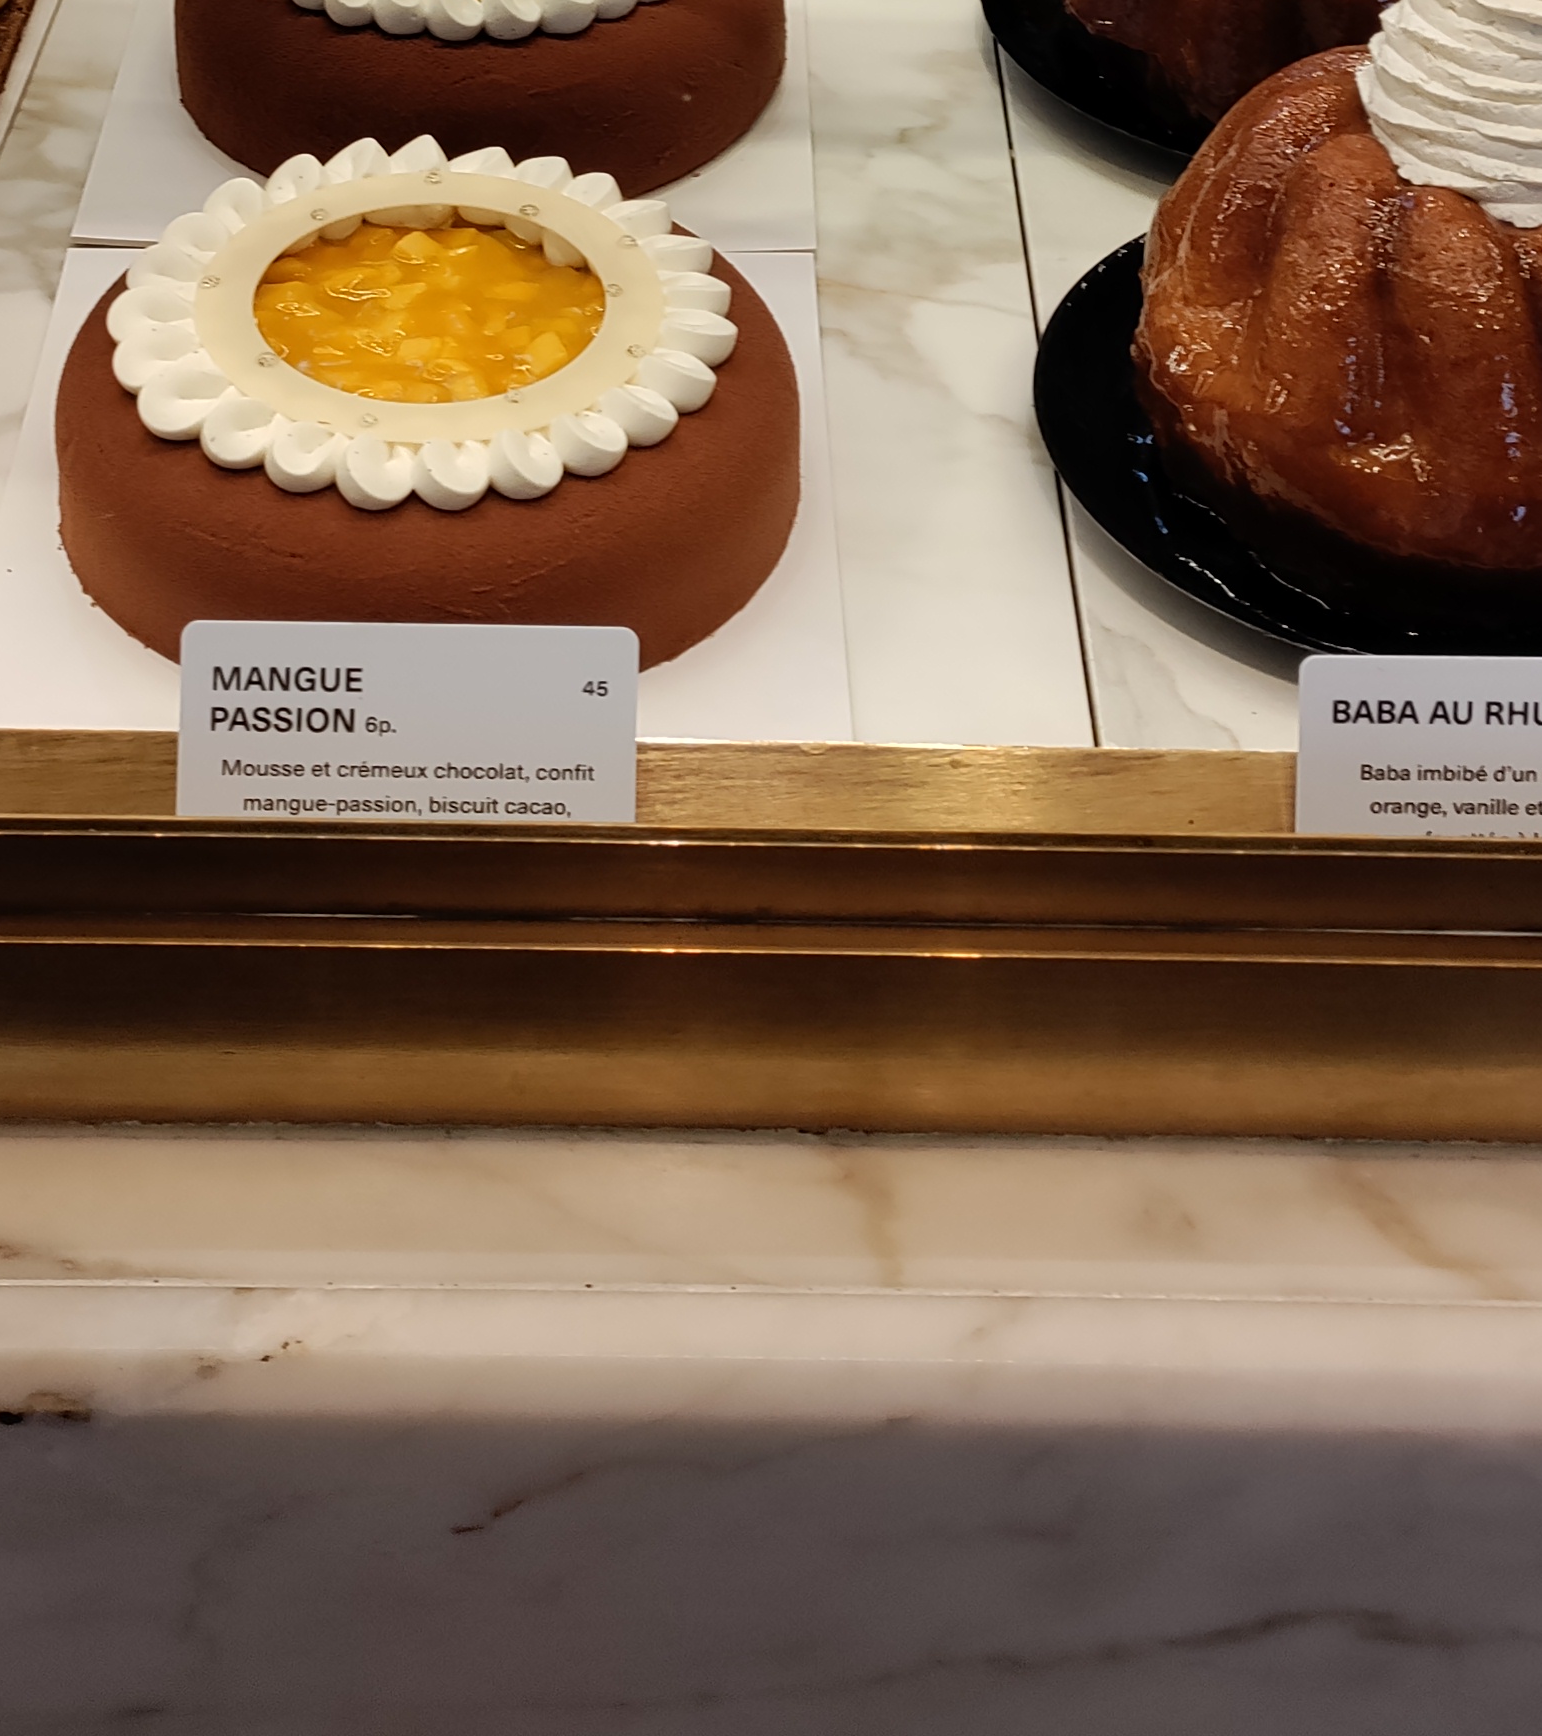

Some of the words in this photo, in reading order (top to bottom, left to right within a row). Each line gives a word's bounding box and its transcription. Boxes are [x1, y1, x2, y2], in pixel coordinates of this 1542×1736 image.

[213, 667, 362, 692] MANGUE
[583, 681, 608, 696] 45
[211, 707, 355, 733] PASSION
[366, 717, 396, 736] 6p.
[1333, 700, 1419, 724] BABA
[1429, 701, 1472, 725] AU
[222, 760, 305, 776] Mousse
[312, 763, 330, 777] et
[337, 762, 428, 778] crémeux
[434, 763, 529, 782] chocolat,
[536, 764, 594, 781] confit
[1361, 764, 1410, 781] Baba
[1418, 765, 1488, 781] imbibé
[244, 796, 421, 816] mangue-passion,
[430, 797, 498, 813] biscuit
[505, 802, 571, 817] cacao,
[1370, 802, 1447, 818] orange,
[1453, 799, 1519, 815] vanille
